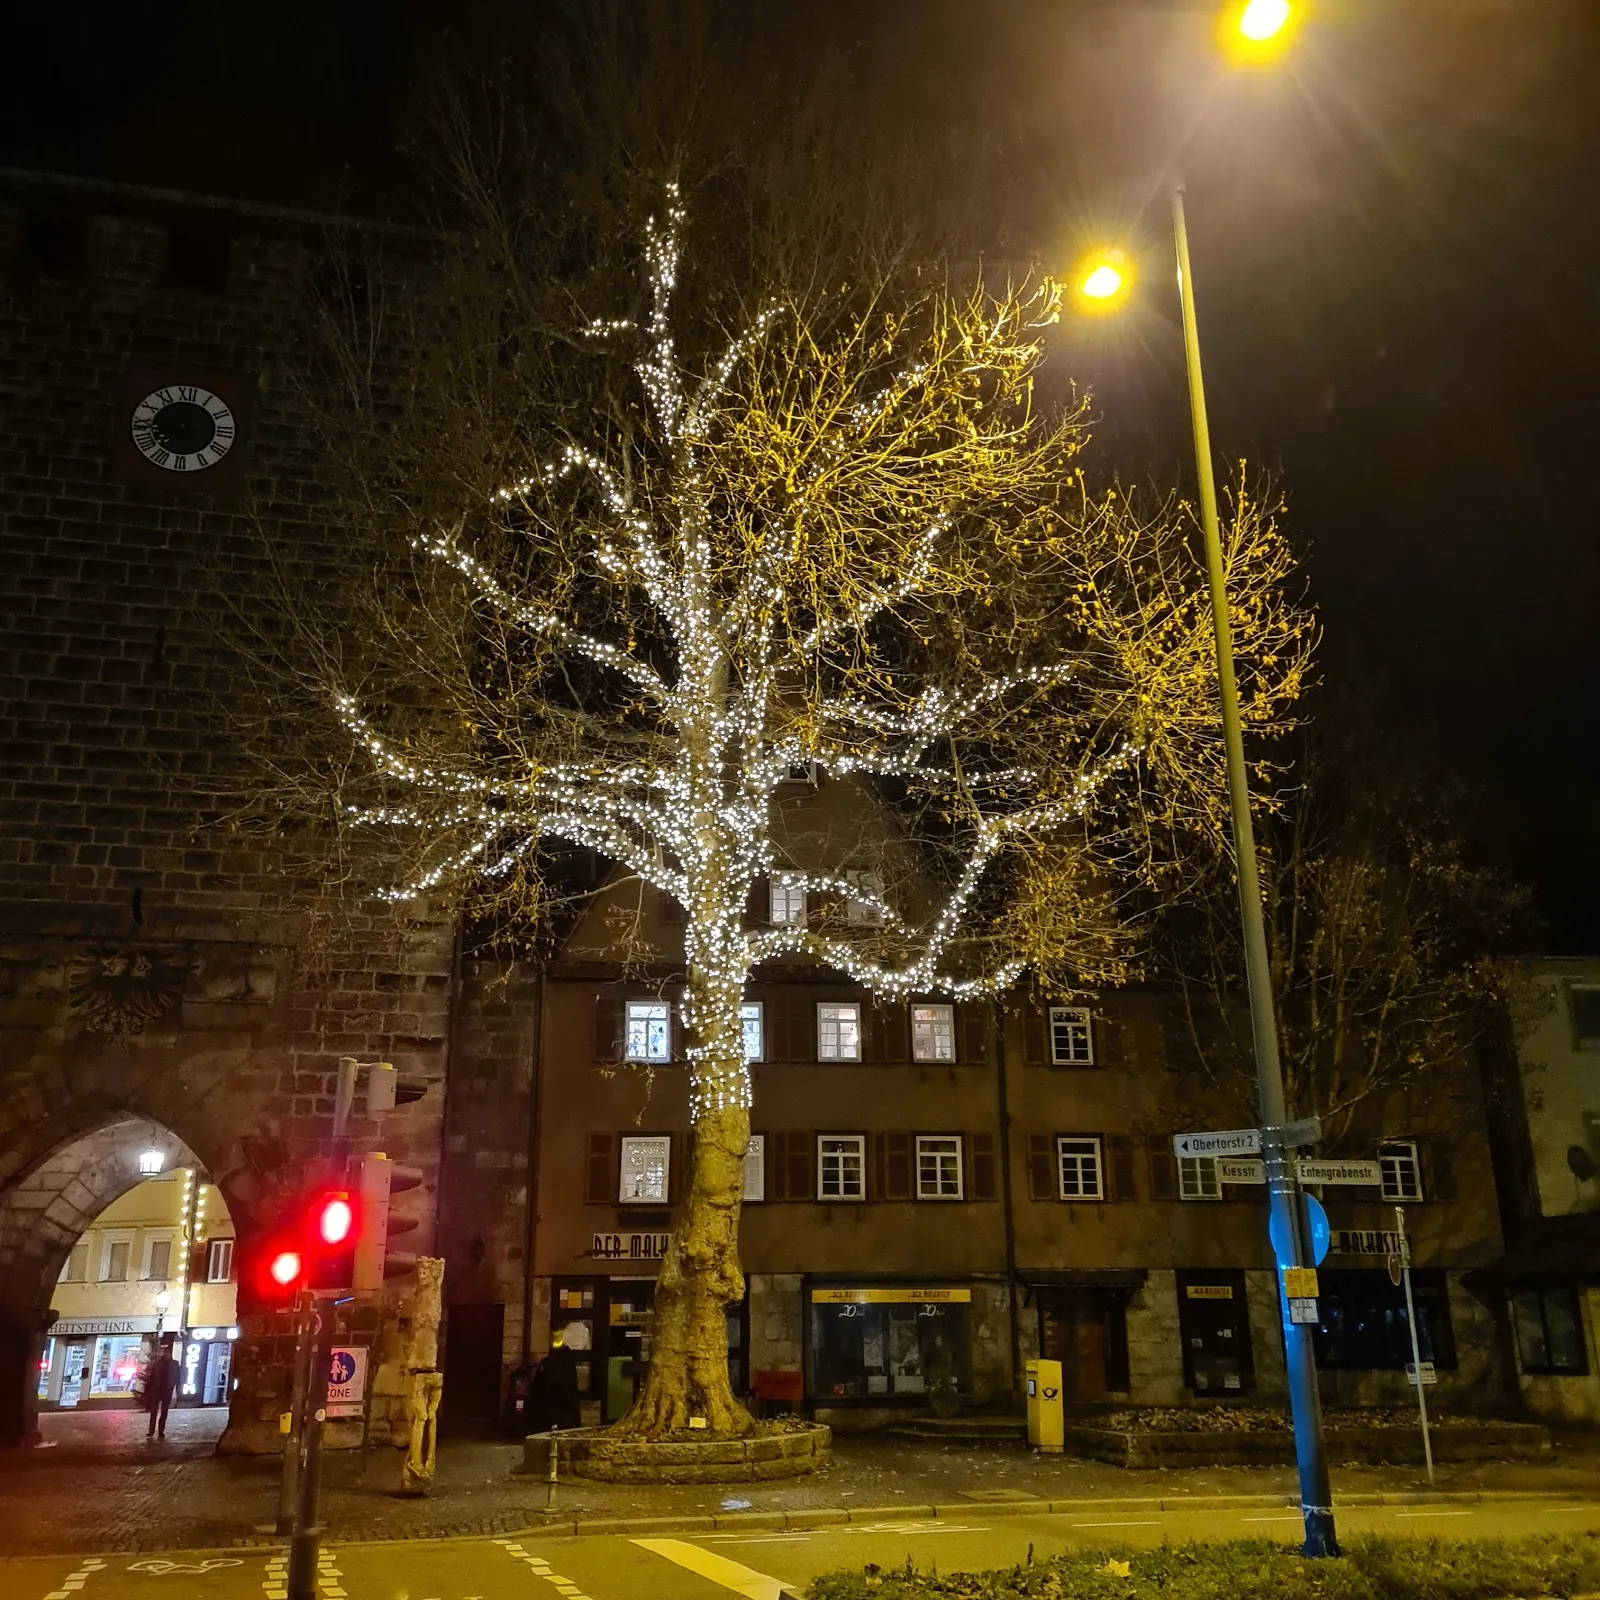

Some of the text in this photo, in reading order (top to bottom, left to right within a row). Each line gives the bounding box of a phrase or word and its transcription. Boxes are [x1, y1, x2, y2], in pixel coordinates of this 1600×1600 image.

[155, 389, 174, 405] XI
[179, 387, 197, 402] XII
[202, 395, 213, 406] I
[141, 401, 158, 413] X
[212, 409, 229, 420] II
[217, 426, 233, 439] III
[1222, 1164, 1258, 1177] Kiesstr.
[1300, 1165, 1374, 1180] Entengrabenstr.
[594, 1234, 621, 1258] DER
